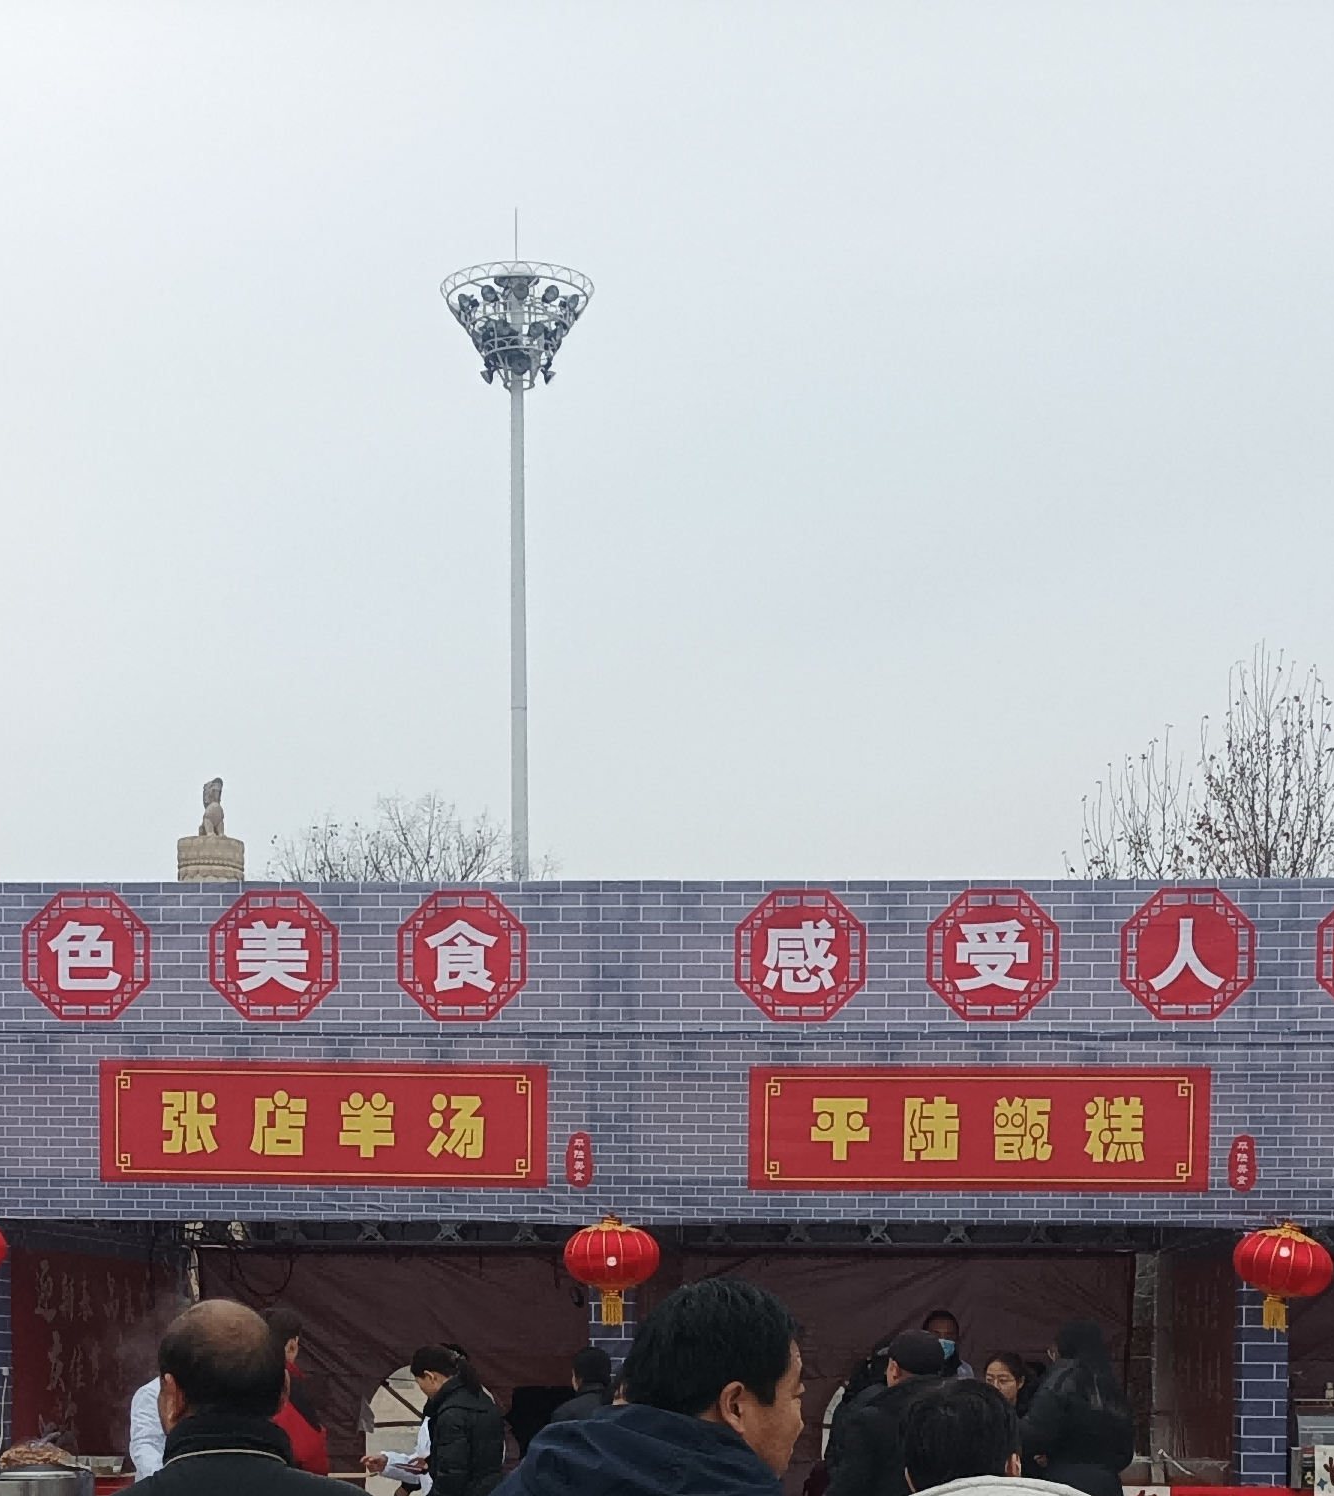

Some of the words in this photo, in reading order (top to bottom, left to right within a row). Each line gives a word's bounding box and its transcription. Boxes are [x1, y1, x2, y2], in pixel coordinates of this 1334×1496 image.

[161, 1090, 485, 1158] 张店羊汤
[809, 1096, 1144, 1163] 平陆甑糕
